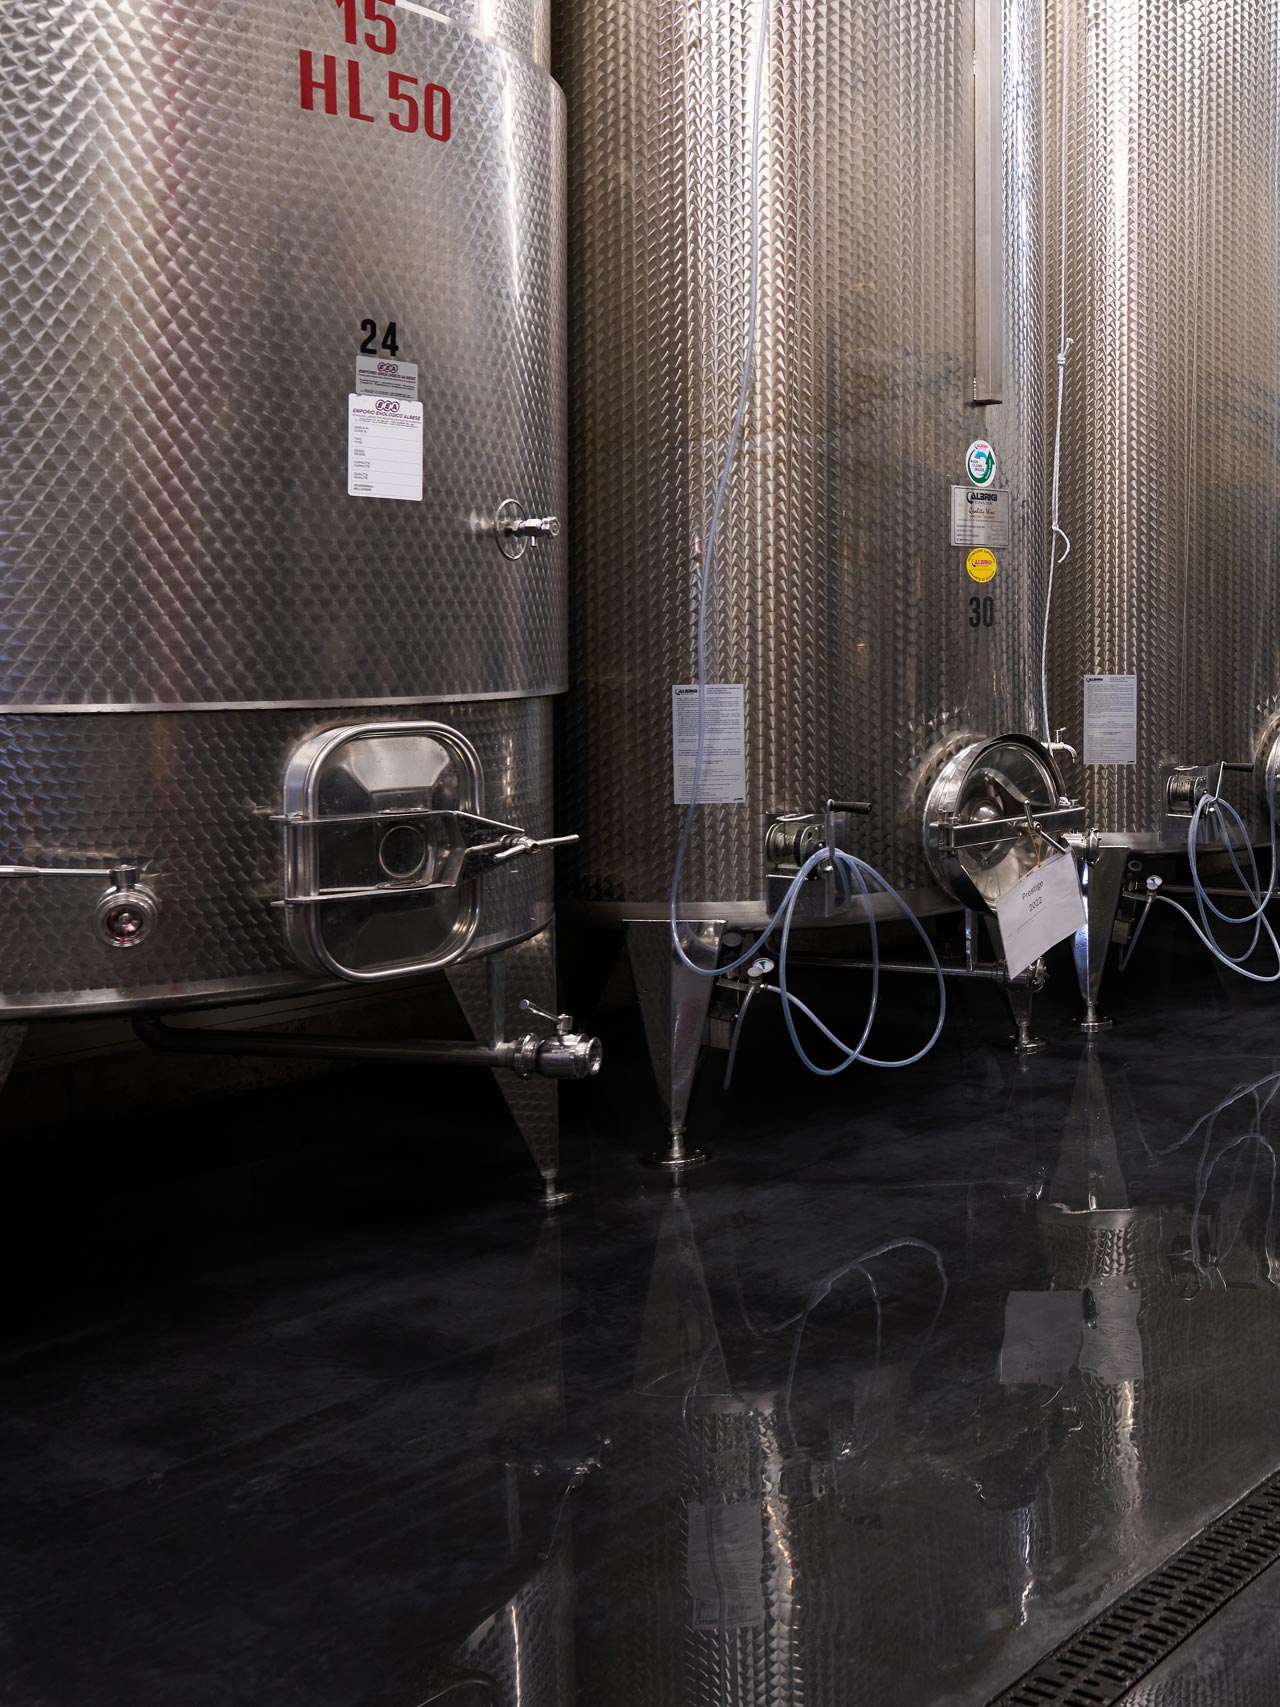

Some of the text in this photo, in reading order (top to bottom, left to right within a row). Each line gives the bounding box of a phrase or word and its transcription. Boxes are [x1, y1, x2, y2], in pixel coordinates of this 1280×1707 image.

[336, 0, 397, 56] 15
[299, 49, 451, 142] HL 50
[360, 318, 399, 357] 24
[375, 411, 403, 419] ENOLOGICO
[376, 400, 400, 412] EEA
[969, 596, 994, 627] 30
[1028, 896, 1042, 912] 2022
